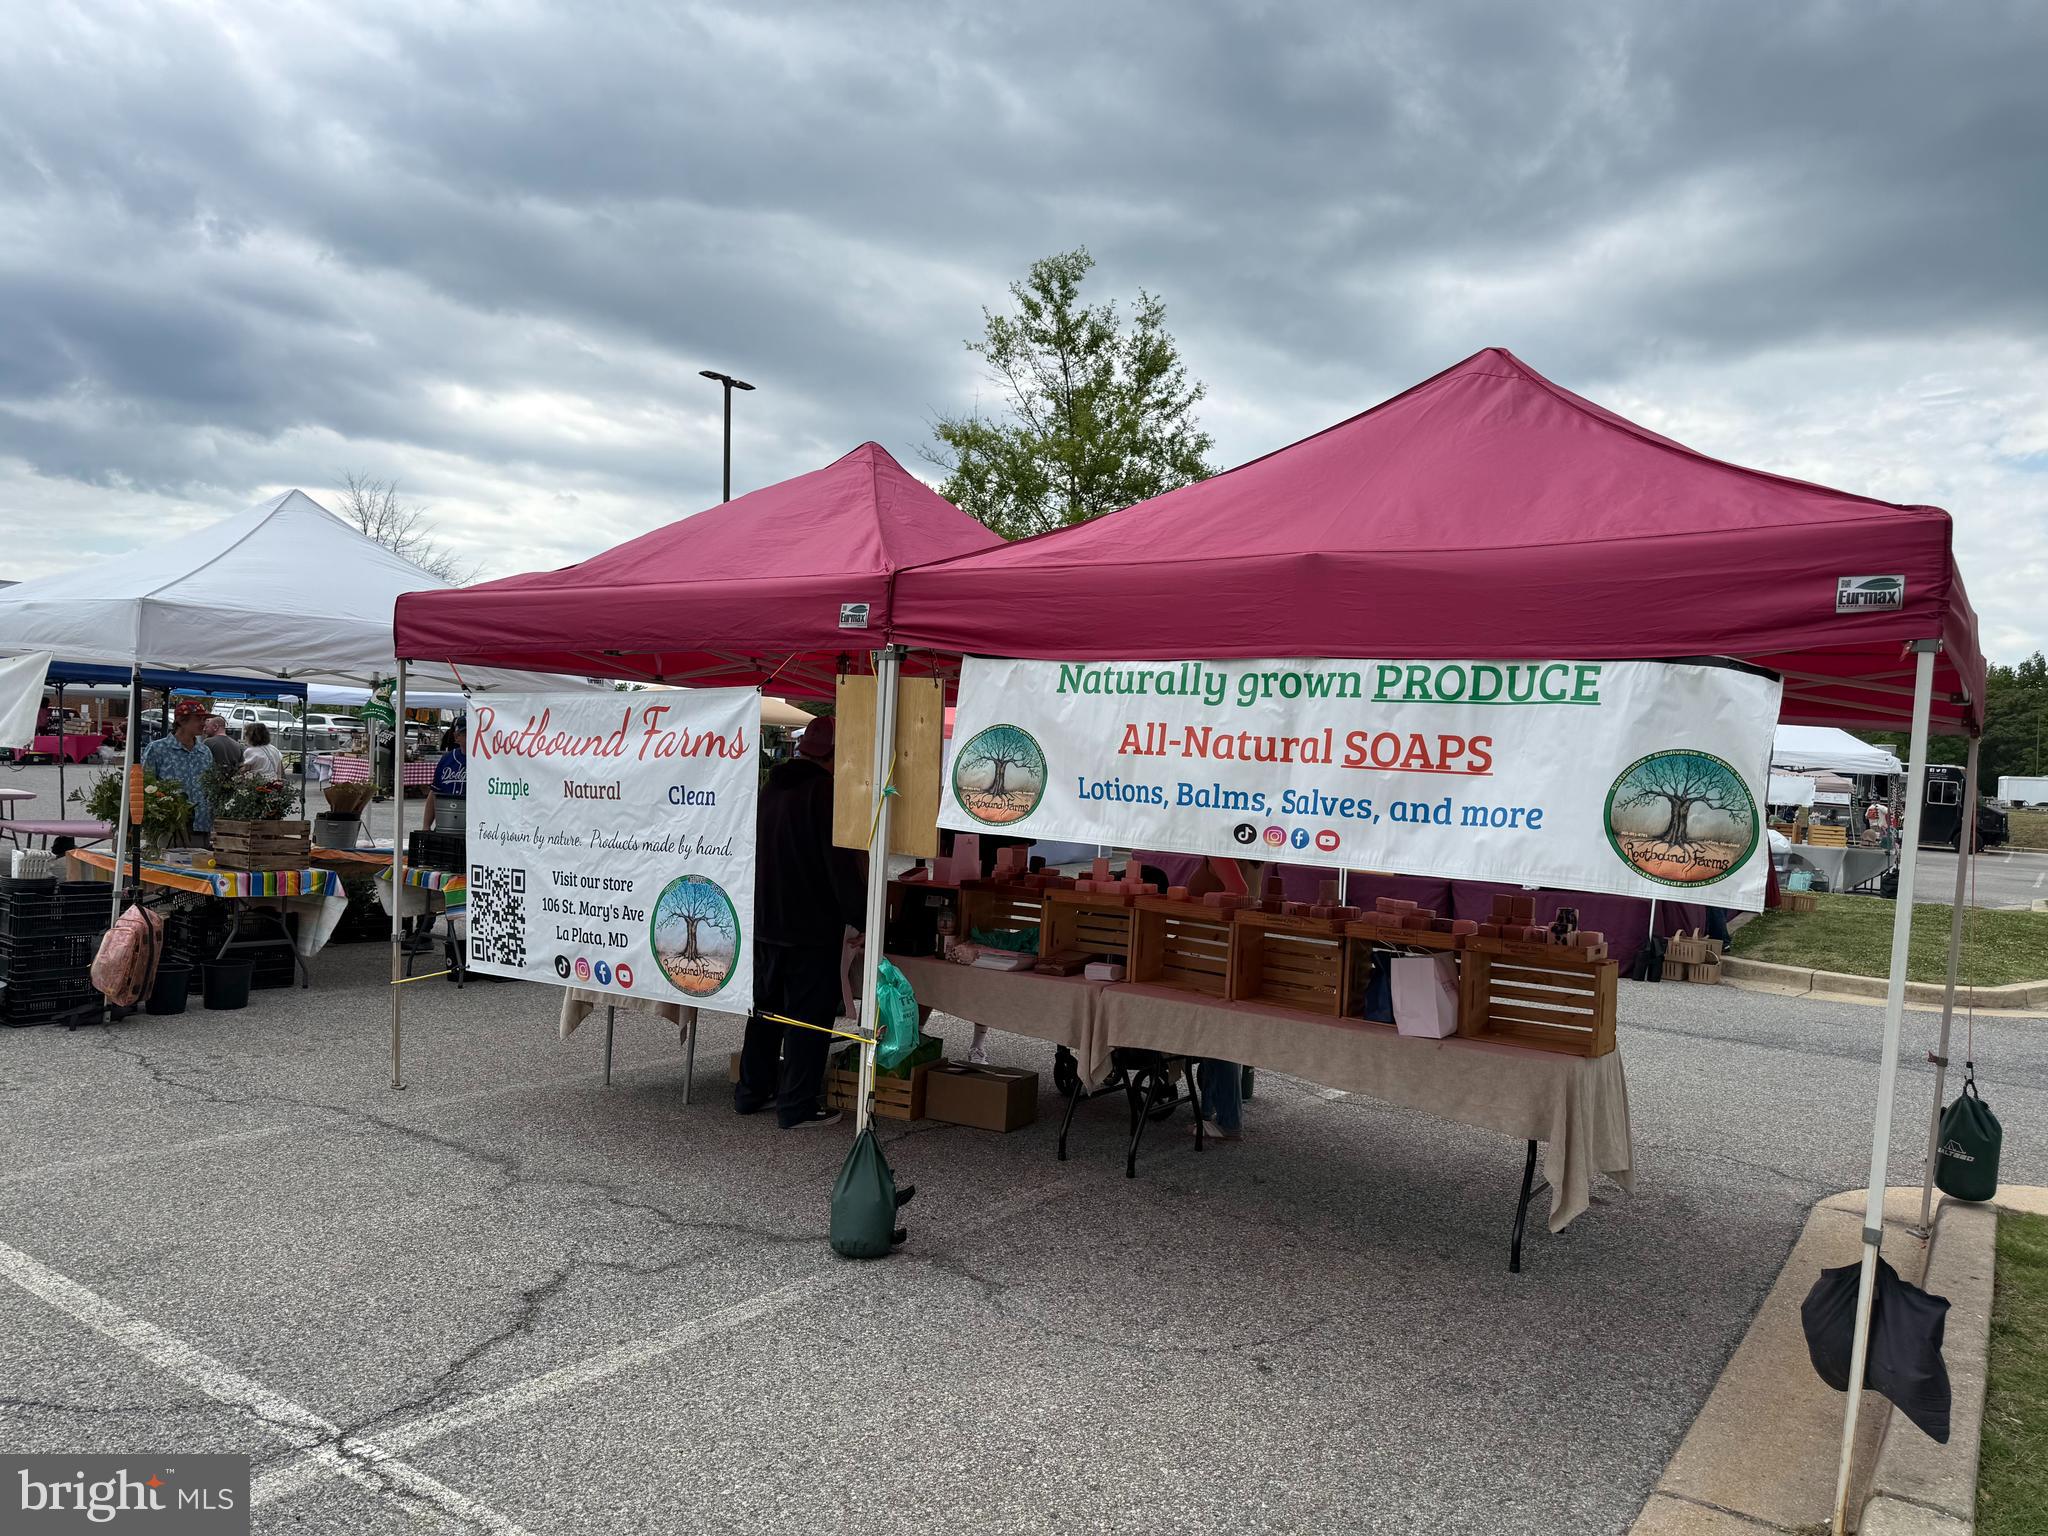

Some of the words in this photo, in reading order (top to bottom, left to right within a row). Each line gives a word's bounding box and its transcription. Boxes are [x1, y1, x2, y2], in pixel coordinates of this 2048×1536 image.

[1838, 590, 1897, 605] Eurmax
[1056, 662, 1228, 706] Naturally
[1237, 671, 1362, 707] grown
[1373, 664, 1602, 702] PRODUCE
[472, 706, 632, 760] Rootbound
[638, 705, 751, 761] Farms
[1118, 722, 1334, 764] All-Natural
[1343, 730, 1493, 773] SOAPS
[1611, 758, 1646, 791] Sustainable
[1653, 749, 1699, 758] Biodiverse
[1707, 754, 1736, 774] Organic
[488, 777, 529, 800] Simple
[564, 780, 621, 800] Natural
[668, 785, 716, 806] Clean
[1006, 798, 1030, 813] Farms
[1078, 776, 1169, 809] Lotions,
[1176, 782, 1272, 817] Balms,
[1281, 789, 1380, 824] Salves,
[1389, 797, 1452, 825] and
[1460, 803, 1543, 830] more
[479, 821, 500, 841] Food
[500, 830, 531, 846] grown
[533, 826, 545, 849] by
[547, 830, 582, 847] nature.
[590, 829, 639, 851] Products
[642, 833, 675, 853] made
[678, 834, 692, 860] by
[696, 835, 733, 857] hand.
[1624, 842, 1689, 863] Rootbound
[1692, 848, 1730, 871] Farms
[552, 870, 578, 887] Visit
[580, 876, 601, 889] our
[602, 877, 634, 892] store
[1627, 861, 1728, 888] RootboundFarms.com
[542, 897, 560, 912] 106
[562, 899, 576, 915] St.
[579, 900, 619, 922] Mary's
[621, 905, 644, 922] Ave
[556, 925, 569, 941] La
[571, 927, 606, 948] Plata,
[608, 932, 628, 948] MD
[701, 963, 725, 981] Farms
